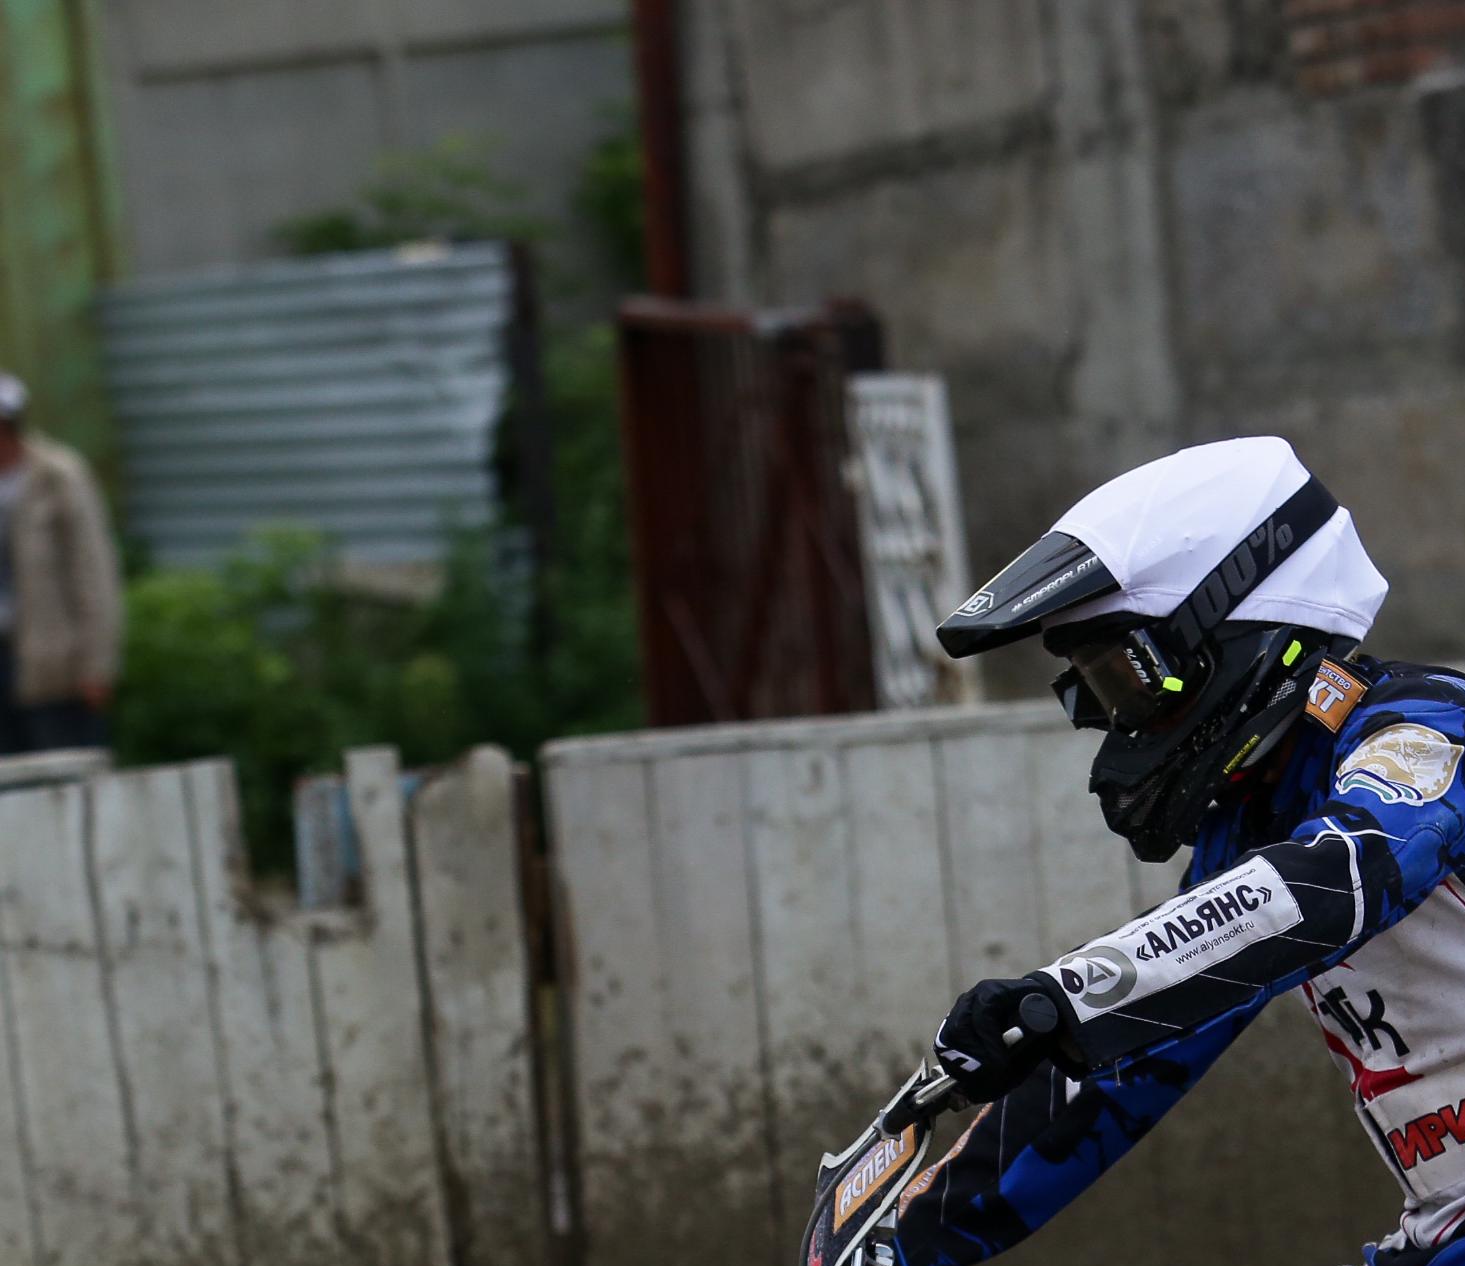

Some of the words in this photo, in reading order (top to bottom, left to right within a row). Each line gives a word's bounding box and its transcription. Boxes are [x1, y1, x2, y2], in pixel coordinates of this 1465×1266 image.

[1170, 517, 1294, 651] 100%
[1136, 885, 1272, 962] «АЛЬЯНС»
[1175, 920, 1255, 965] www.alyansokt.ru
